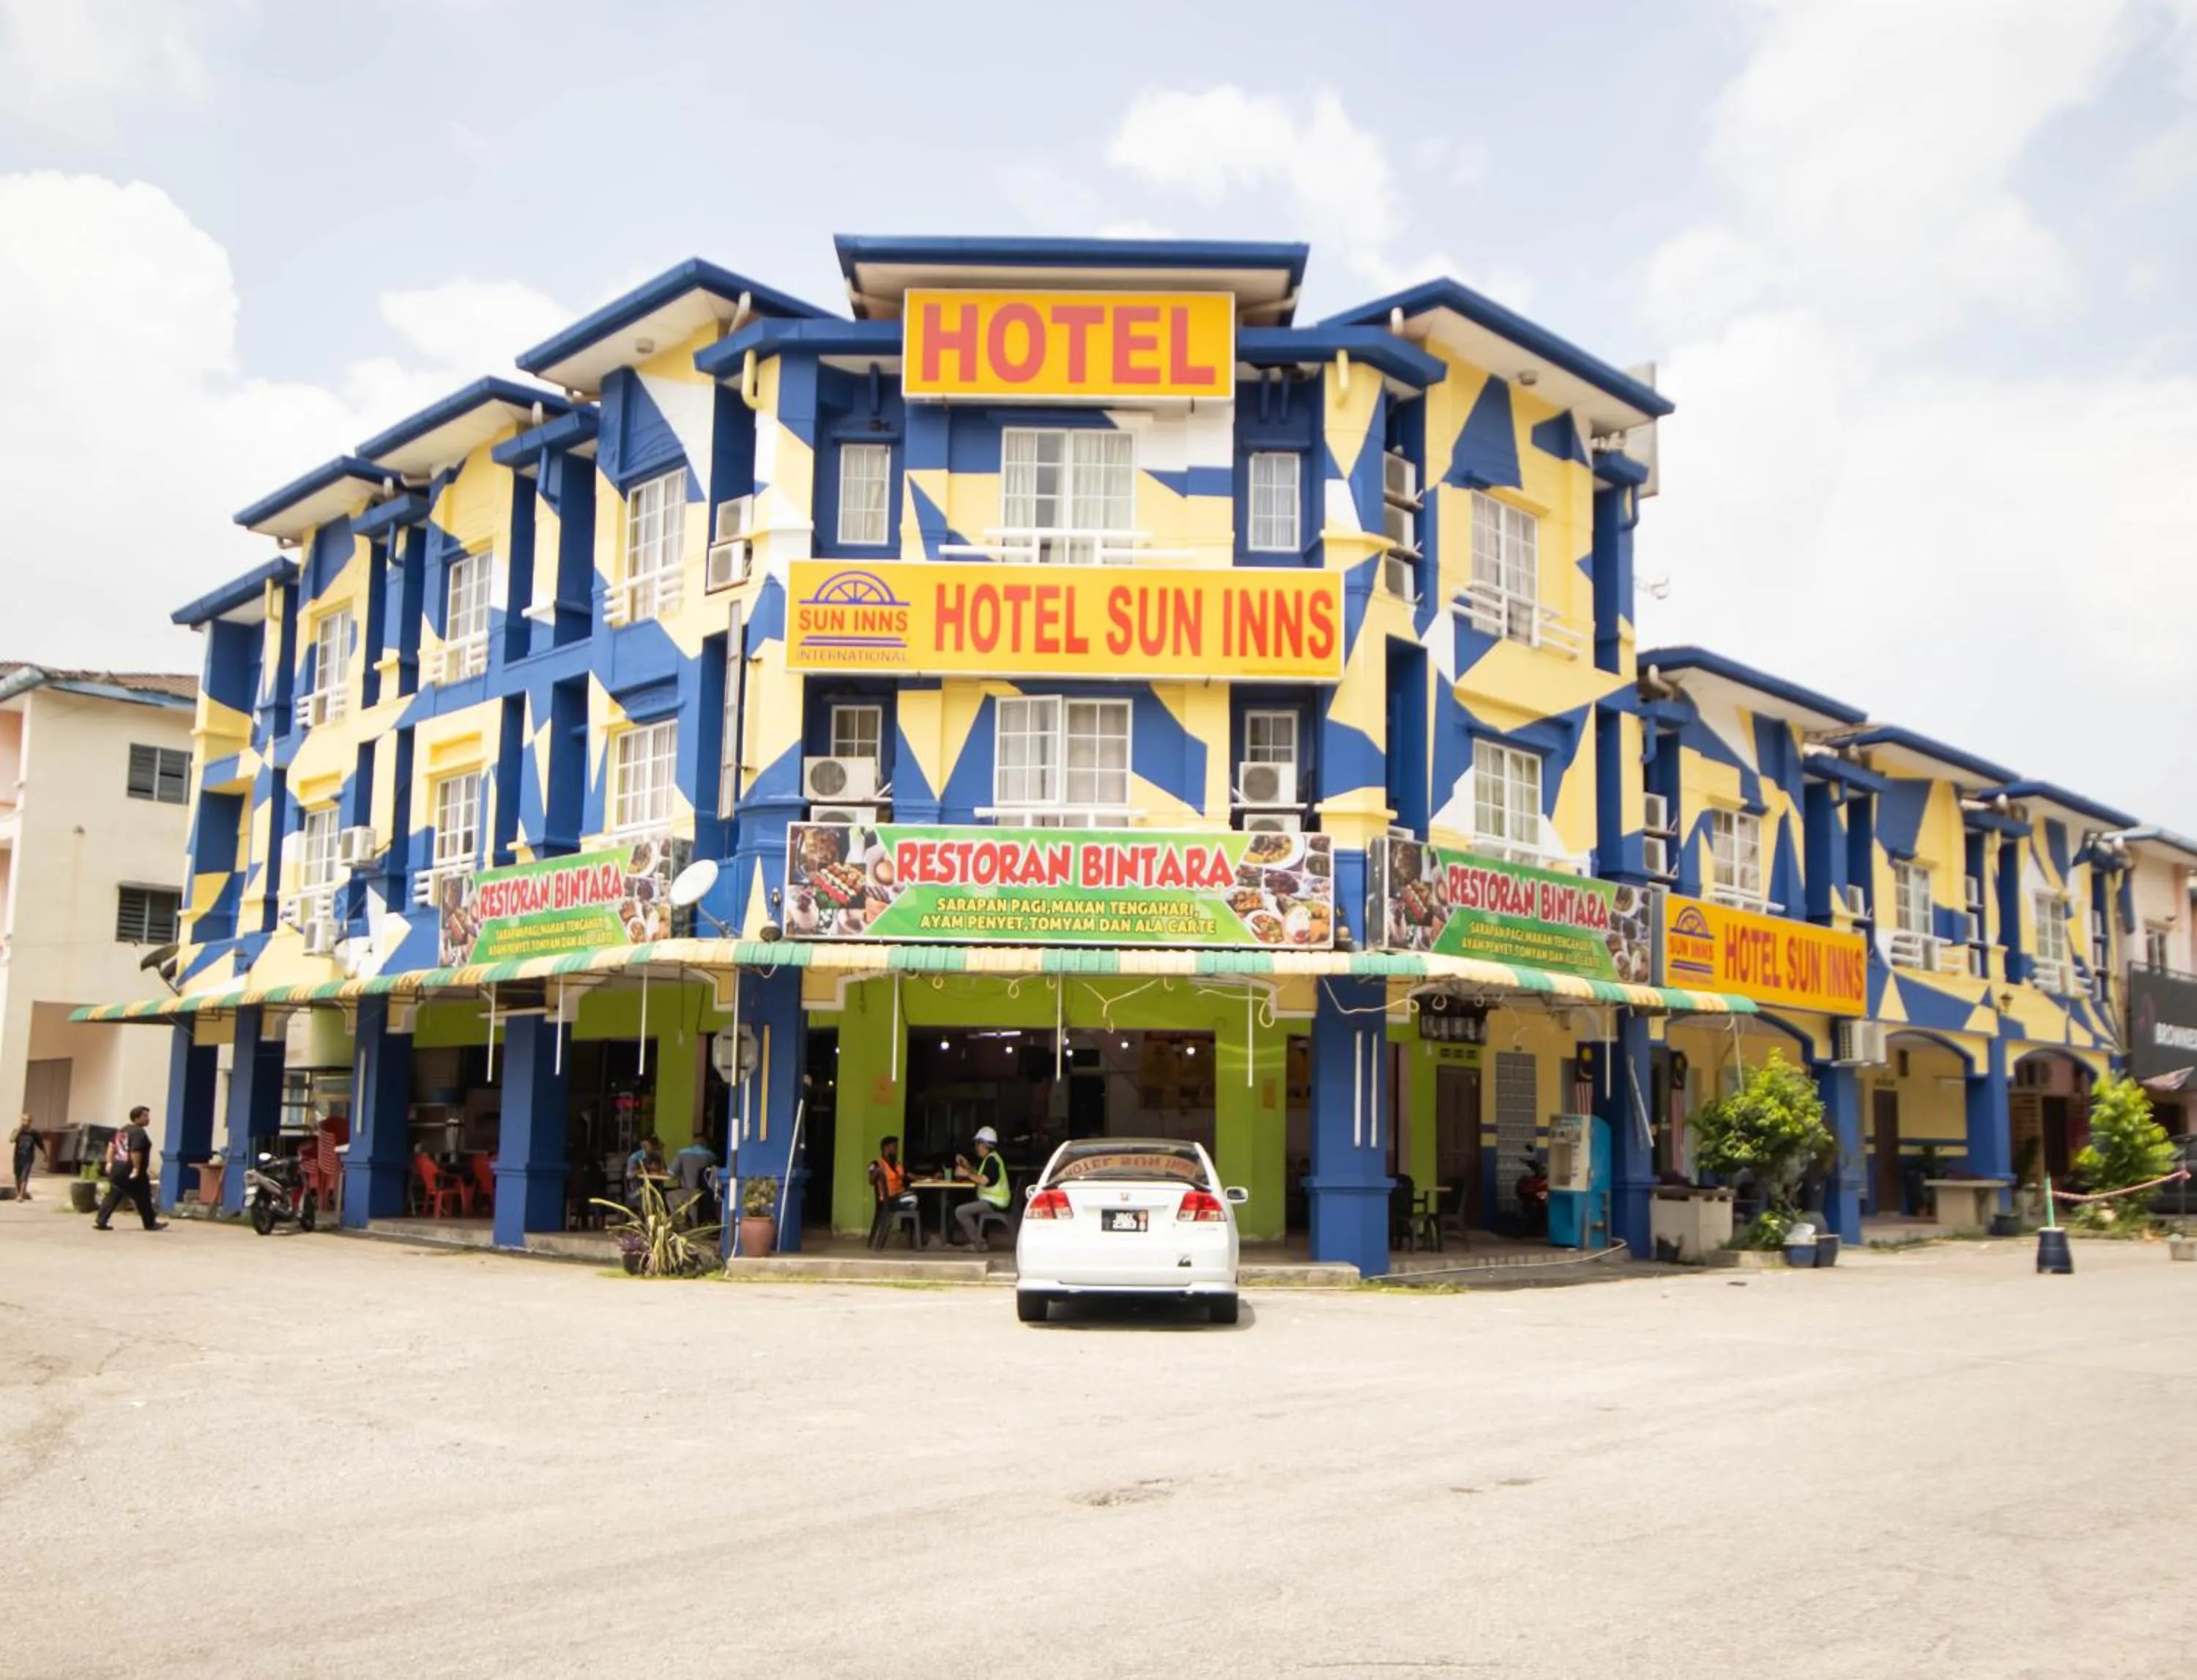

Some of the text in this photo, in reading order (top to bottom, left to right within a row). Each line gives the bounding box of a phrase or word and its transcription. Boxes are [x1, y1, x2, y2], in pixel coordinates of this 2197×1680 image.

[921, 302, 1216, 385] HOTEL
[798, 609, 909, 632] SUN INNS
[935, 583, 1336, 660] HOTEL SUN INNS
[796, 649, 909, 663] INTERNATIONAL
[896, 841, 1236, 888] RESTORAN BINTARA
[479, 863, 624, 919] RESTORAN BINTARA
[937, 898, 1008, 913] SARAPAN
[1447, 865, 1610, 930] RESTORAN BINTARA
[921, 915, 963, 929] AYAM
[1099, 918, 1131, 932] DAN
[1135, 920, 1167, 933] ALA
[1169, 920, 1216, 935] CARTE
[1725, 923, 1864, 1001] HOTEL SUN INNS
